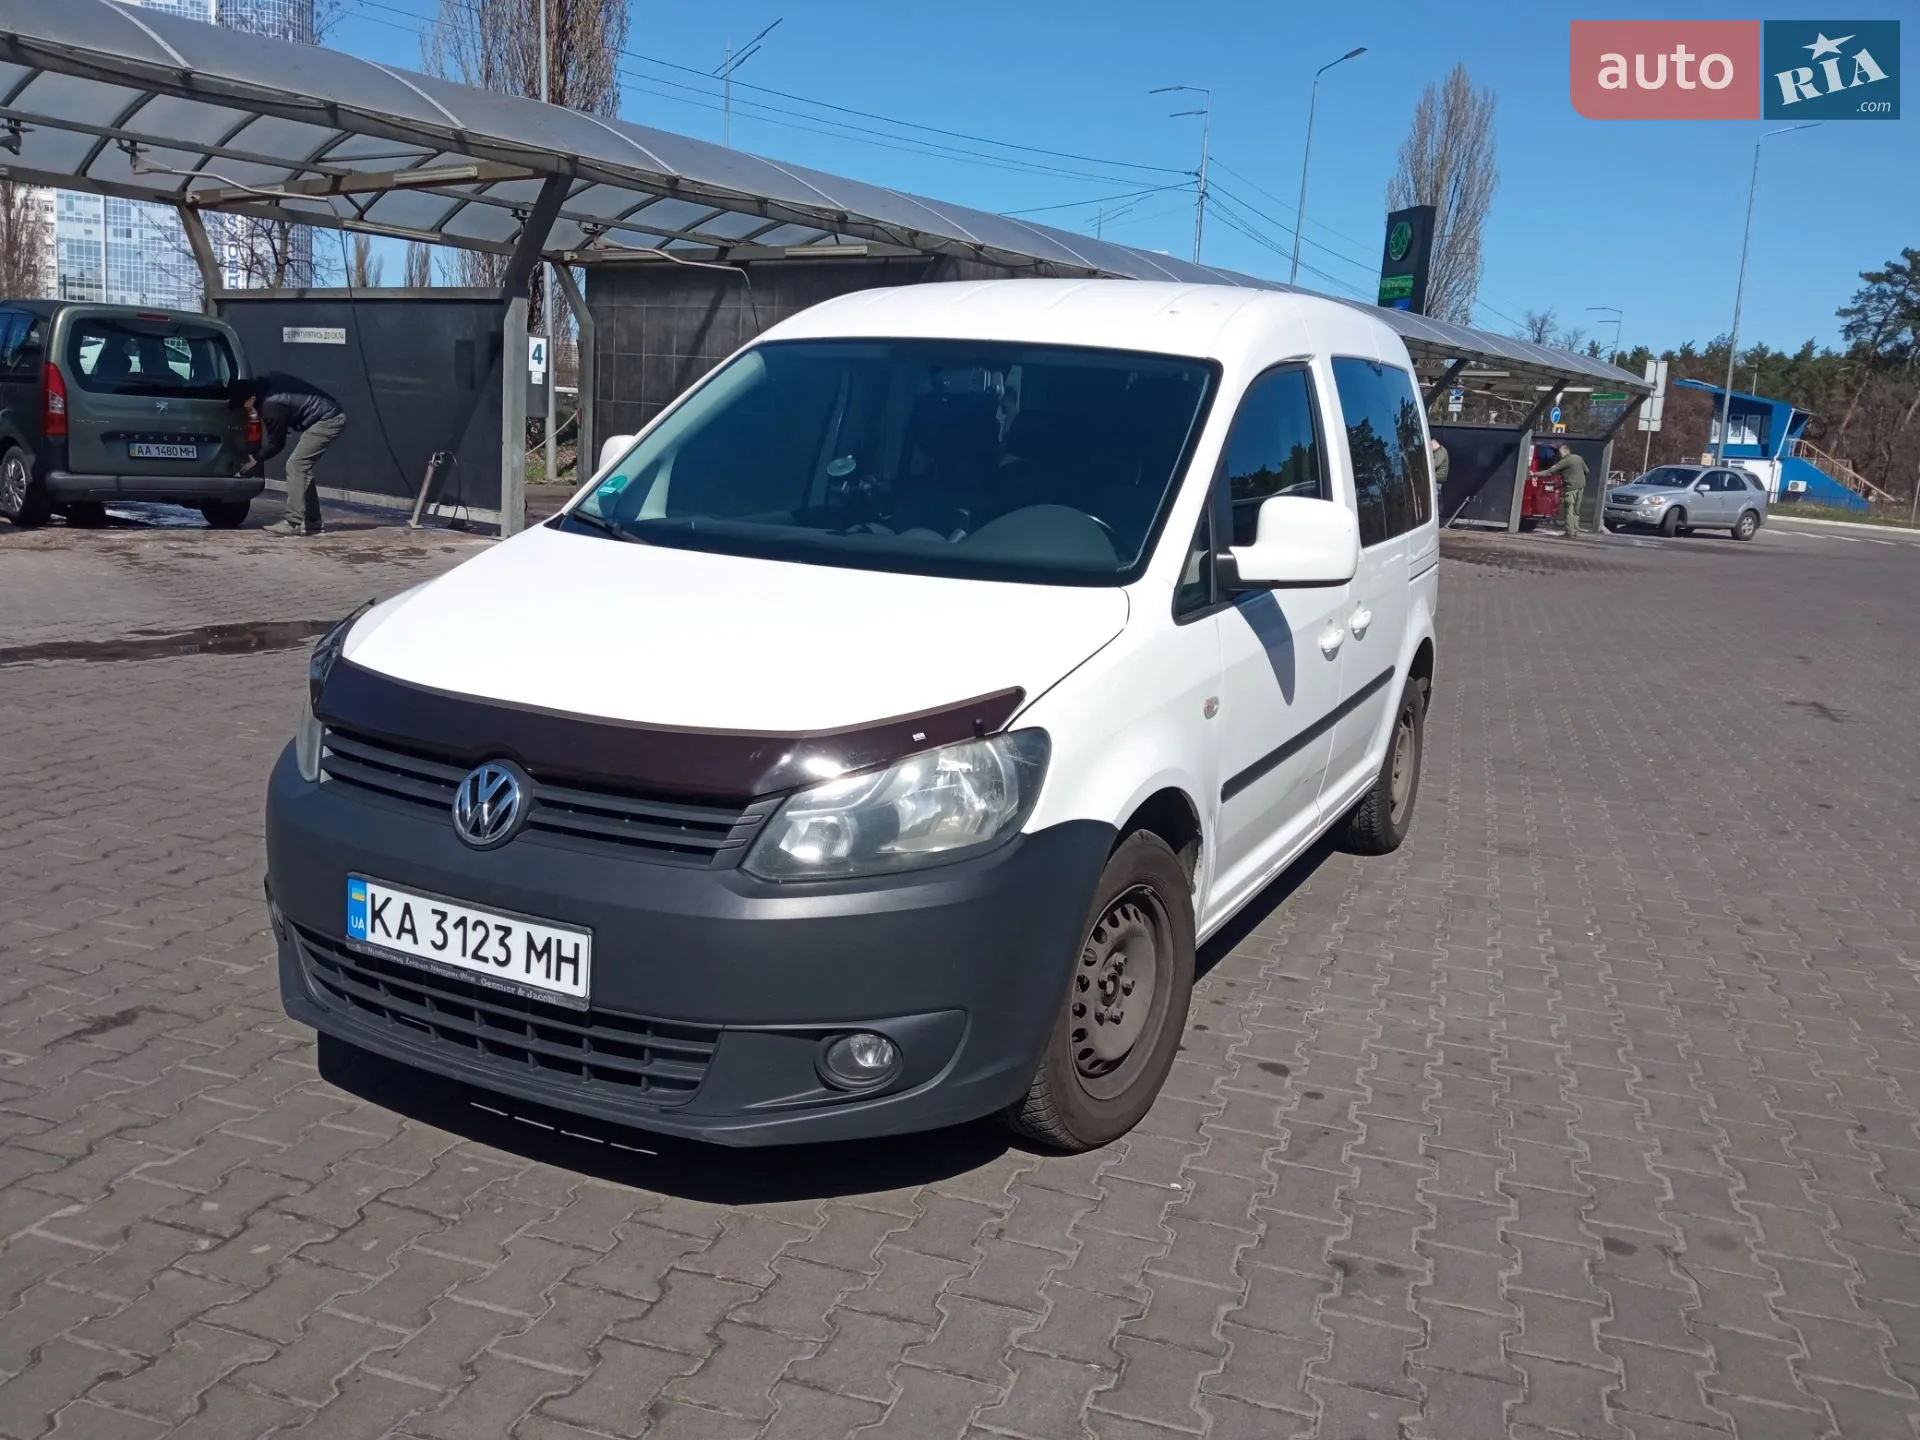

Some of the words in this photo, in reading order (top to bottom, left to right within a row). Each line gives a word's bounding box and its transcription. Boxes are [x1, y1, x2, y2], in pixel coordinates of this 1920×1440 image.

[531, 343, 544, 365] 4
[137, 444, 151, 456] AA
[156, 445, 178, 457] 1480
[179, 445, 195, 458] MH
[351, 915, 365, 931] UA
[370, 893, 419, 945] KA
[430, 908, 512, 968] 3123
[524, 930, 580, 986] MH
